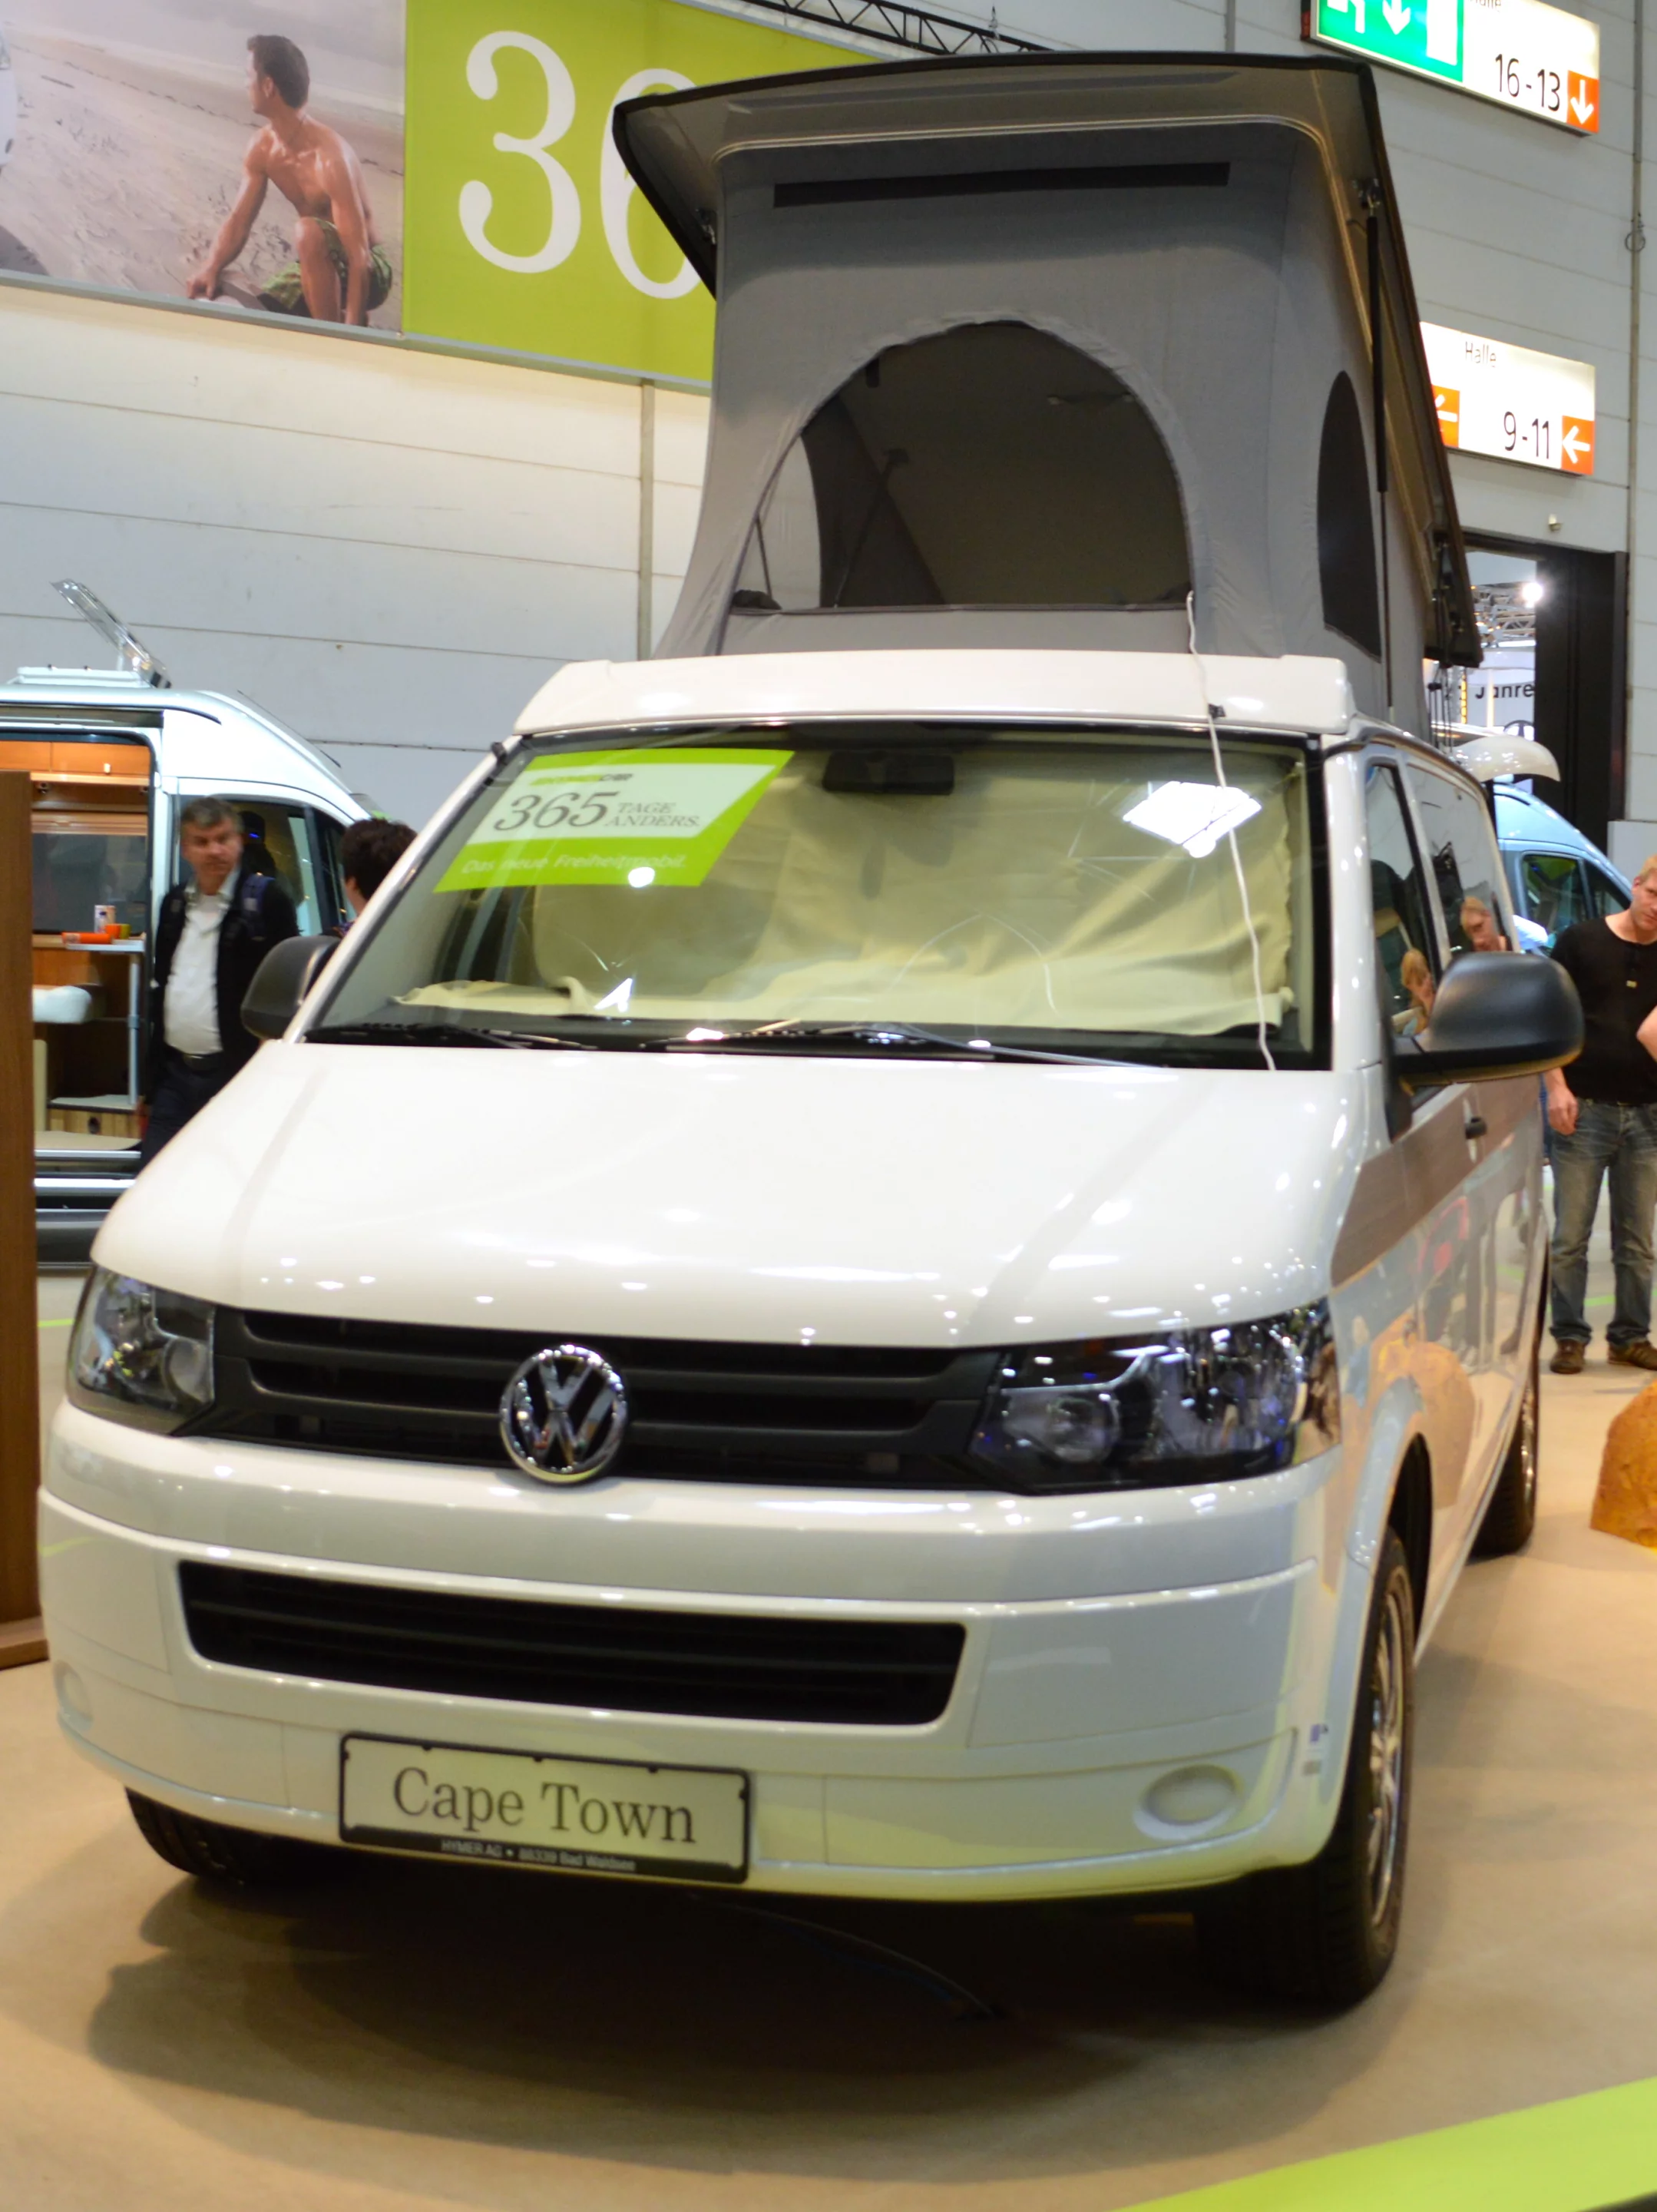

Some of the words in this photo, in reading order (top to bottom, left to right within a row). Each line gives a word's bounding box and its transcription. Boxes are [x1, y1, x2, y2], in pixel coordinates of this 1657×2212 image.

[1465, 341, 1497, 368] Halle
[493, 792, 619, 830] 365
[617, 802, 676, 814] TAGE
[393, 1767, 524, 1833] Cape
[541, 1782, 696, 1843] Town
